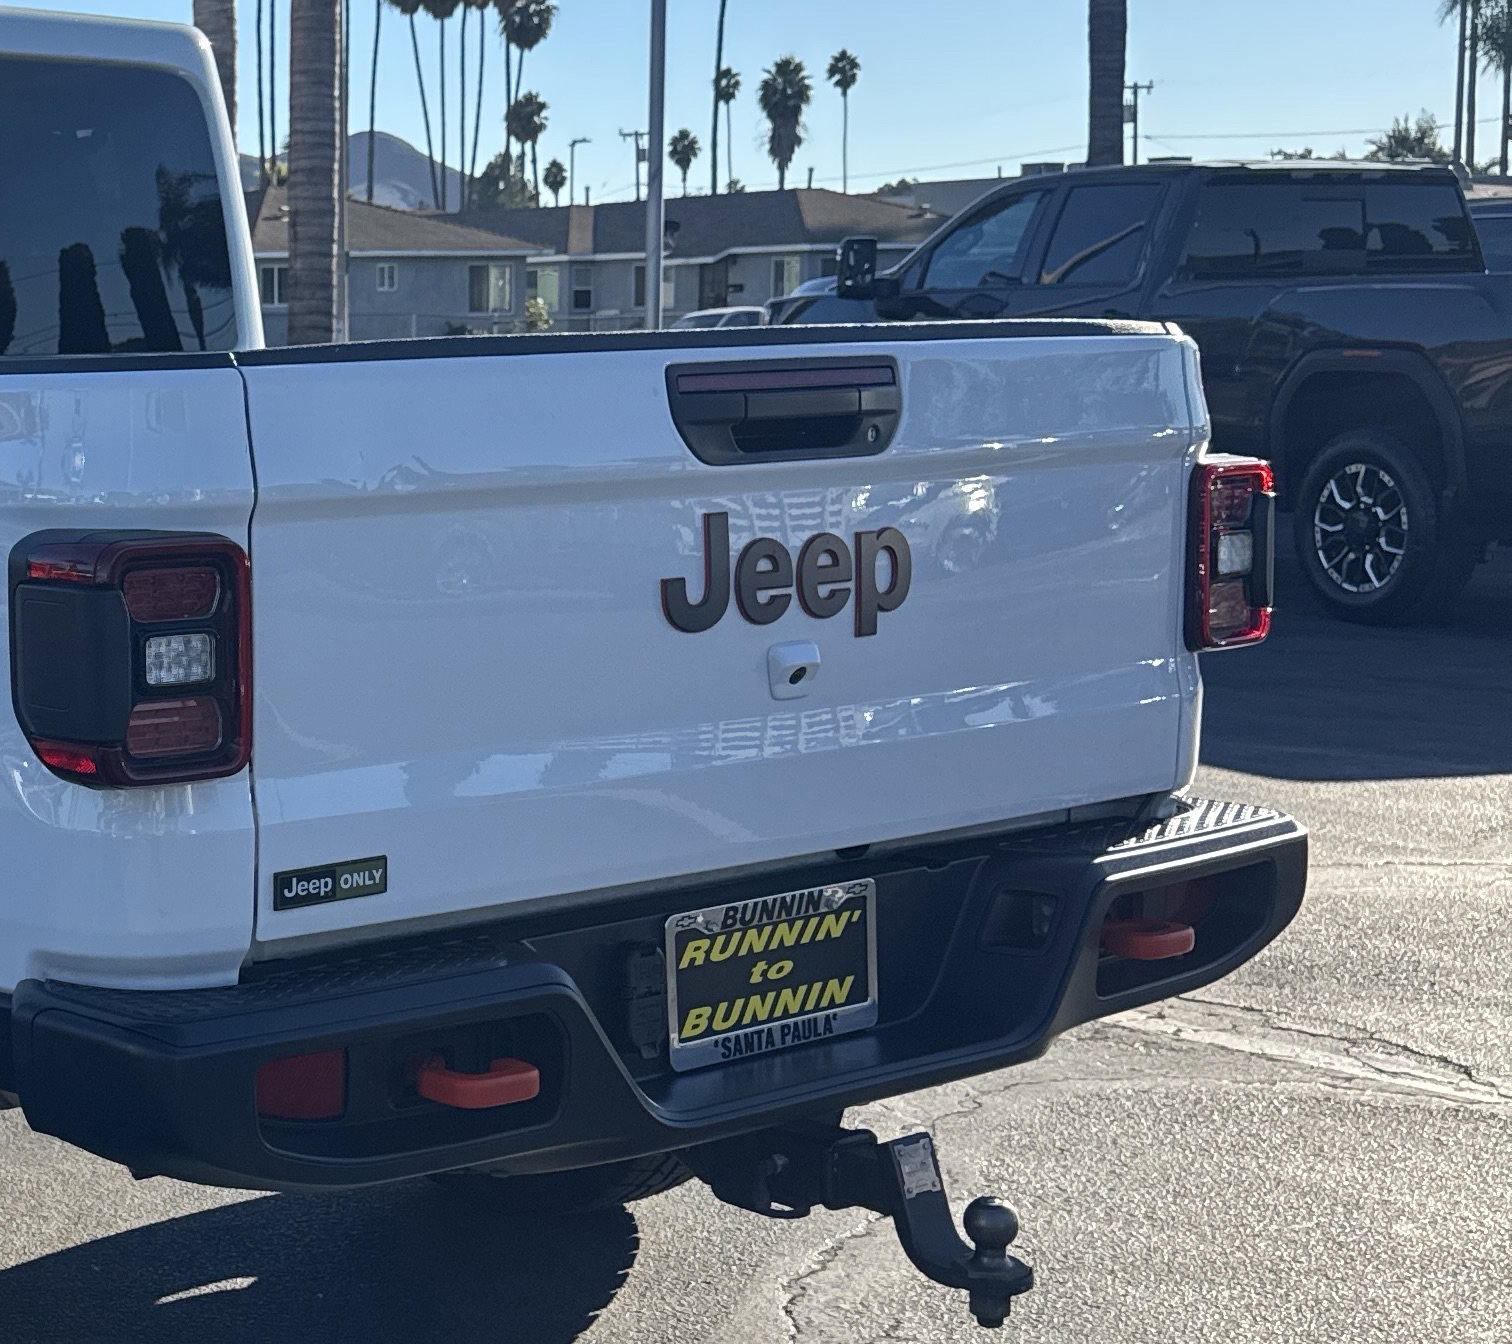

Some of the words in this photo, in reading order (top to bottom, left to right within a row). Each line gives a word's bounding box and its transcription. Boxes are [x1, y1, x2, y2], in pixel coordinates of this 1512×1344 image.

[660, 511, 912, 637] Jeep
[283, 877, 333, 898] Jeep
[340, 868, 383, 889] ONLY
[721, 888, 824, 929] BUNNIN
[678, 910, 863, 970] RUNNIN'
[749, 959, 794, 984] to
[679, 975, 855, 1039] BUNNIN
